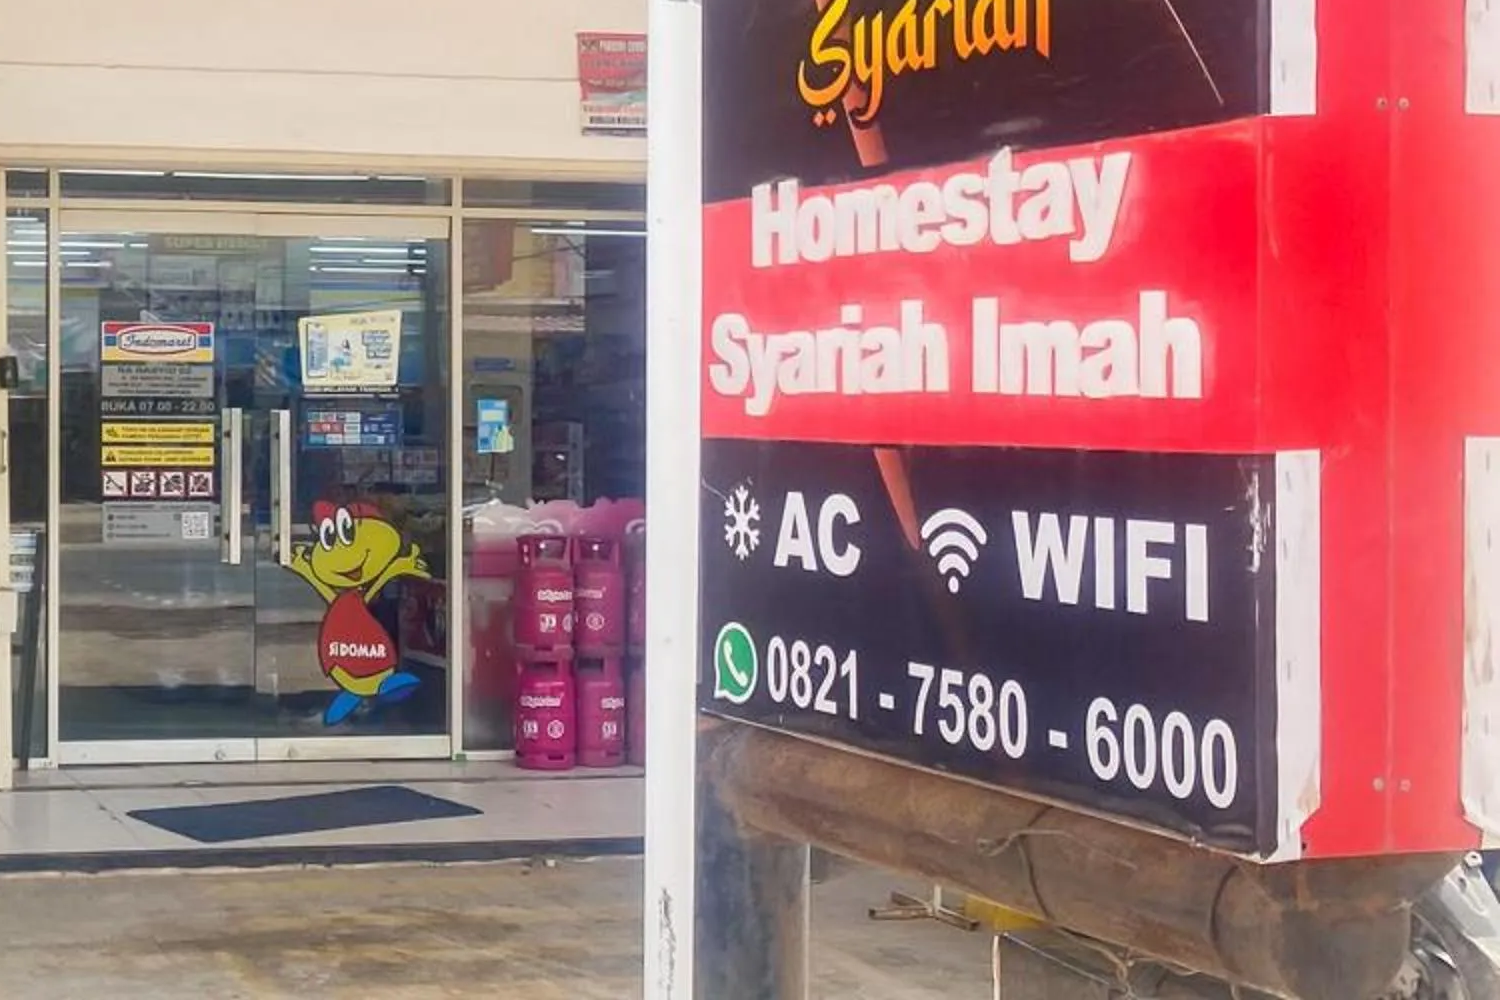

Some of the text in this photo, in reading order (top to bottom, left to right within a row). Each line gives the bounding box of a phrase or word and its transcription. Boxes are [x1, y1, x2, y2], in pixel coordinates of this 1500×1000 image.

[750, 146, 1132, 268] Homestay
[100, 400, 136, 412] BUKA
[708, 290, 1203, 417] Syariah Imah
[773, 491, 862, 578] AC
[1011, 509, 1210, 623] WIFI
[765, 637, 860, 720] 0821
[907, 661, 1029, 761] 7580
[1085, 695, 1240, 811] 6000
